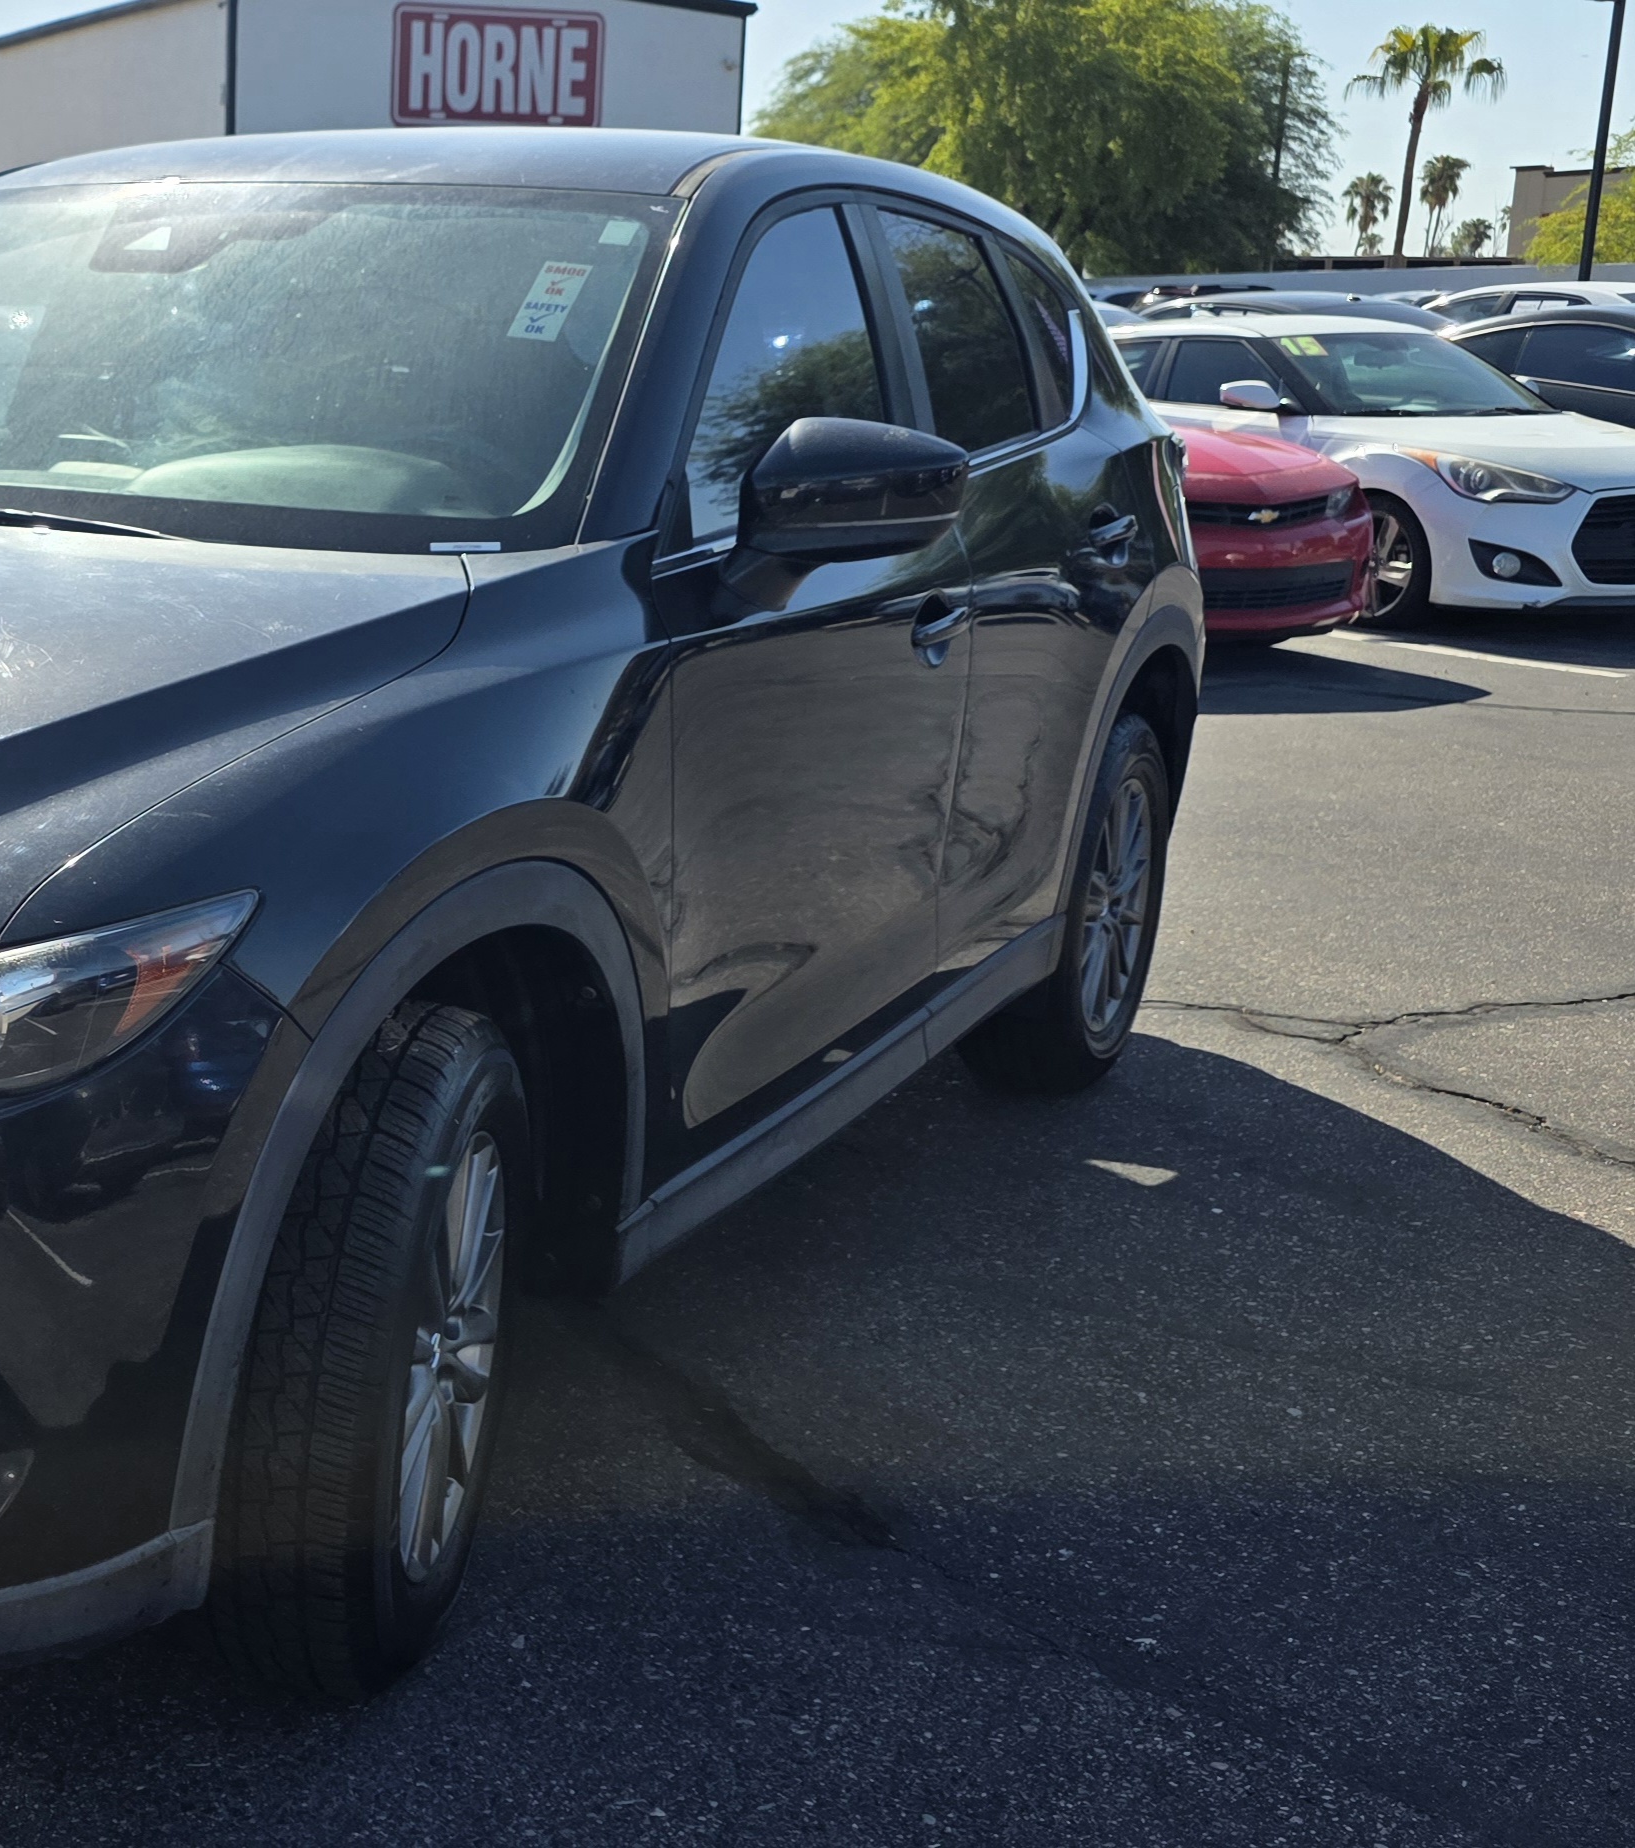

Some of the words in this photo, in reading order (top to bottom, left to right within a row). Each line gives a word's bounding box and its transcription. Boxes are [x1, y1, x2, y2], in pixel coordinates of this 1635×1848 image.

[408, 19, 589, 117] HORNE
[544, 286, 565, 296] OK
[524, 301, 568, 313] SAFETY
[524, 324, 545, 334] OK
[1280, 336, 1320, 356] 15
